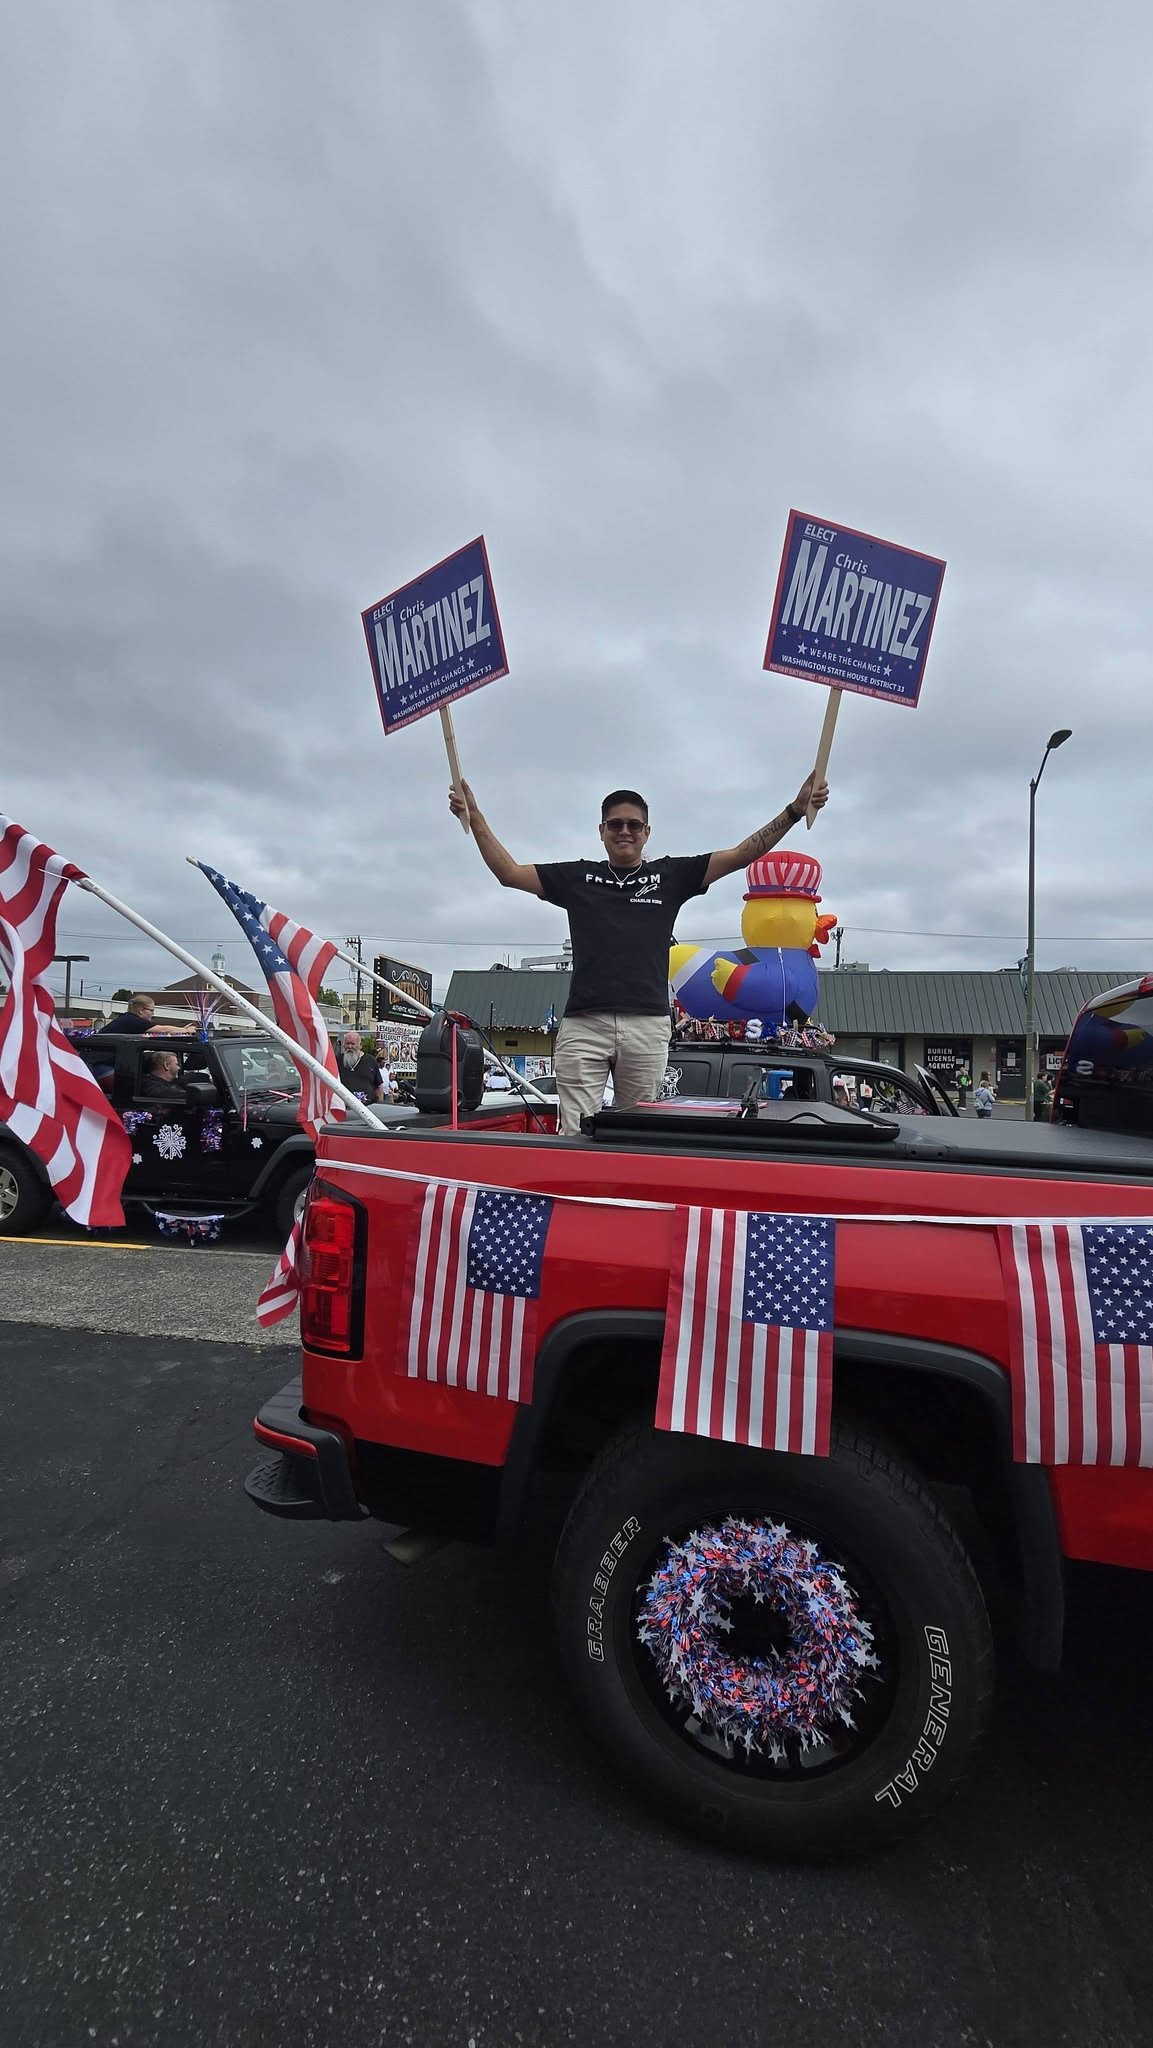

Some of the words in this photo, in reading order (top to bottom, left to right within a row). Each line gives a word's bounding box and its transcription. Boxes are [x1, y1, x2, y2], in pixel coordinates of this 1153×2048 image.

[804, 523, 837, 543] ELECT
[835, 553, 869, 574] Chris
[373, 599, 395, 621] ELECT
[400, 600, 425, 622] Chris
[781, 539, 933, 661] MARTINEZ
[374, 574, 492, 694] MARTINEZ
[810, 647, 821, 658] WE
[822, 651, 837, 662] ARE
[838, 655, 852, 666] THE
[852, 659, 881, 673] CHANGE
[408, 691, 418, 701] WE
[418, 686, 429, 695] ARE
[429, 680, 441, 690] THE
[441, 665, 466, 683] CHANGE
[781, 654, 827, 672] WASHINGTON
[827, 666, 846, 677] STATE
[846, 671, 868, 683] HOUSE
[869, 677, 897, 691] DISTRICT
[897, 684, 905, 693] 33
[392, 699, 426, 720] WASHINGTON
[425, 691, 440, 704] STATE
[440, 683, 458, 696] HOUSE
[459, 670, 484, 685] DISTRICT
[484, 664, 492, 673] 33
[585, 873, 661, 885] FROM
[927, 1047, 953, 1055] BURIEN
[928, 1062, 955, 1070] AGENCY
[587, 1515, 642, 1662] GRABBER
[874, 1625, 952, 1808] GENERAL
